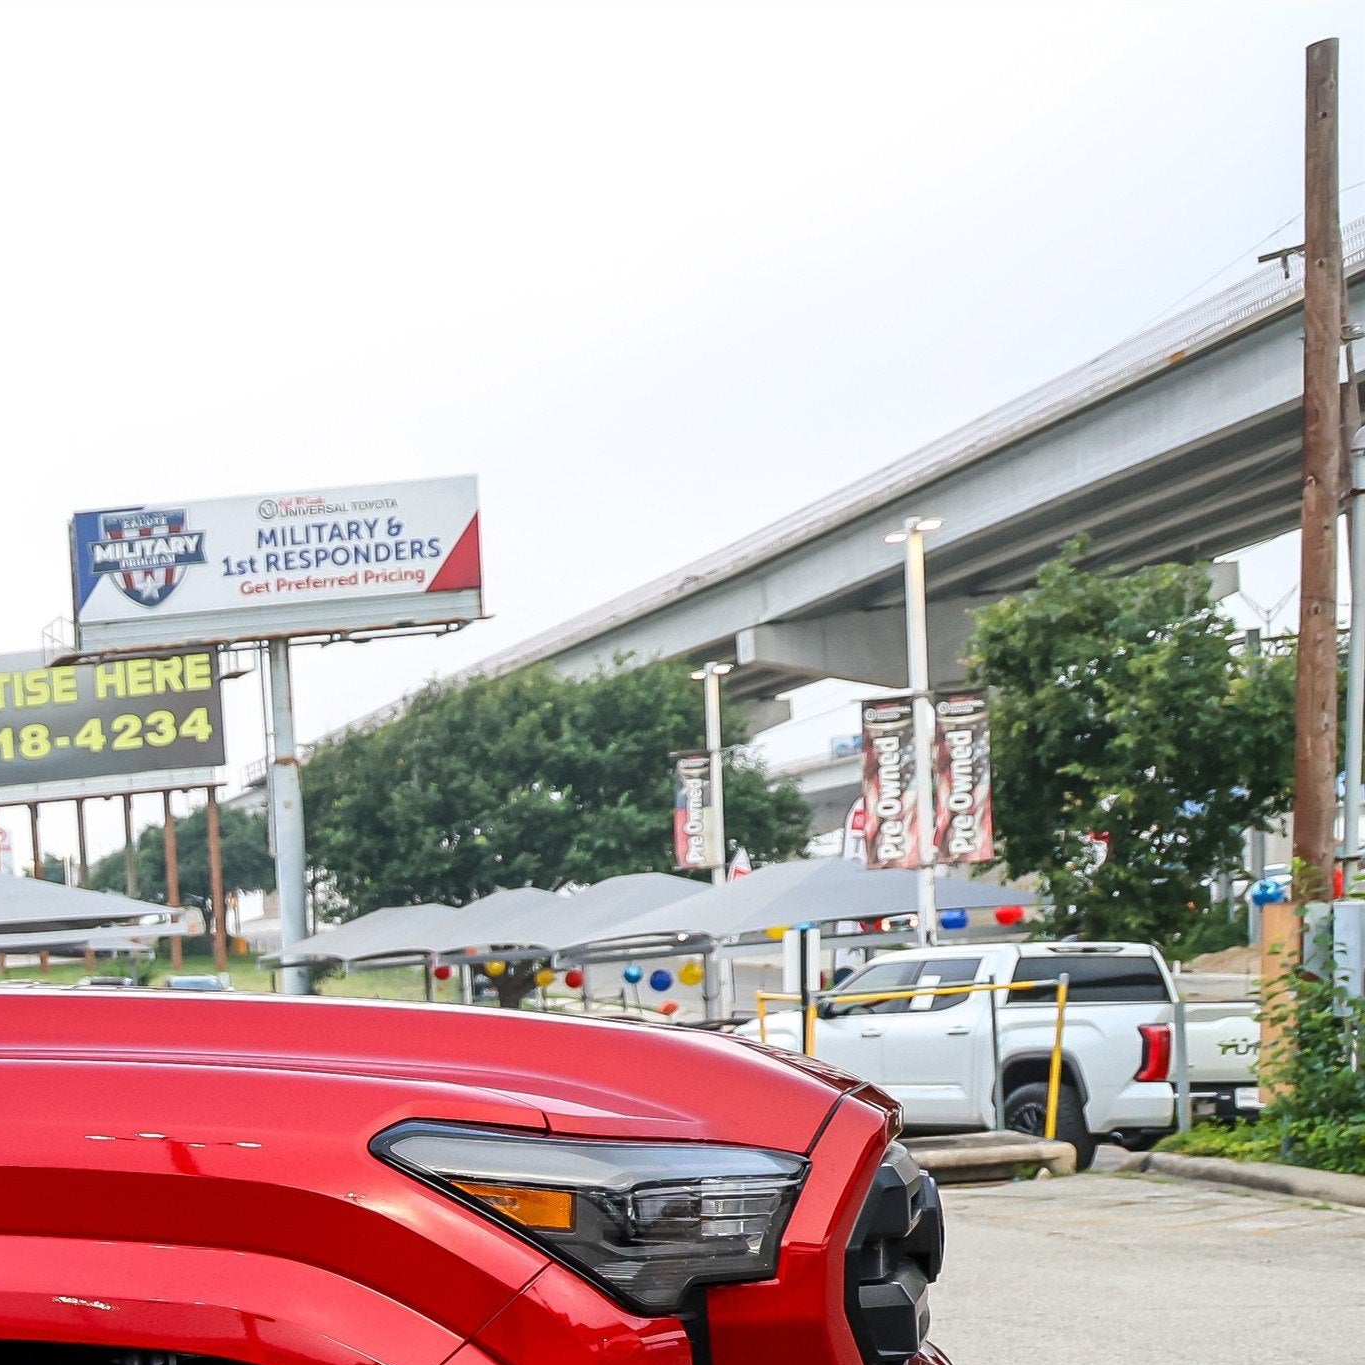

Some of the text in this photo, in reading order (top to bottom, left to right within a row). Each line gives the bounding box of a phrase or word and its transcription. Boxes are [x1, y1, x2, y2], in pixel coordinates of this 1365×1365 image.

[279, 498, 399, 518] UNIVERSAL TOYOTA
[93, 534, 200, 563] MILITARY
[257, 516, 403, 548] MILITARY &
[222, 537, 442, 577] 1st RESPONDERS
[240, 568, 426, 596] Get Preferred Pricing
[94, 653, 212, 699] HERE
[872, 736, 902, 818] Owned
[944, 730, 974, 812] Owned
[877, 820, 905, 860] Pre
[948, 814, 976, 853] Pre
